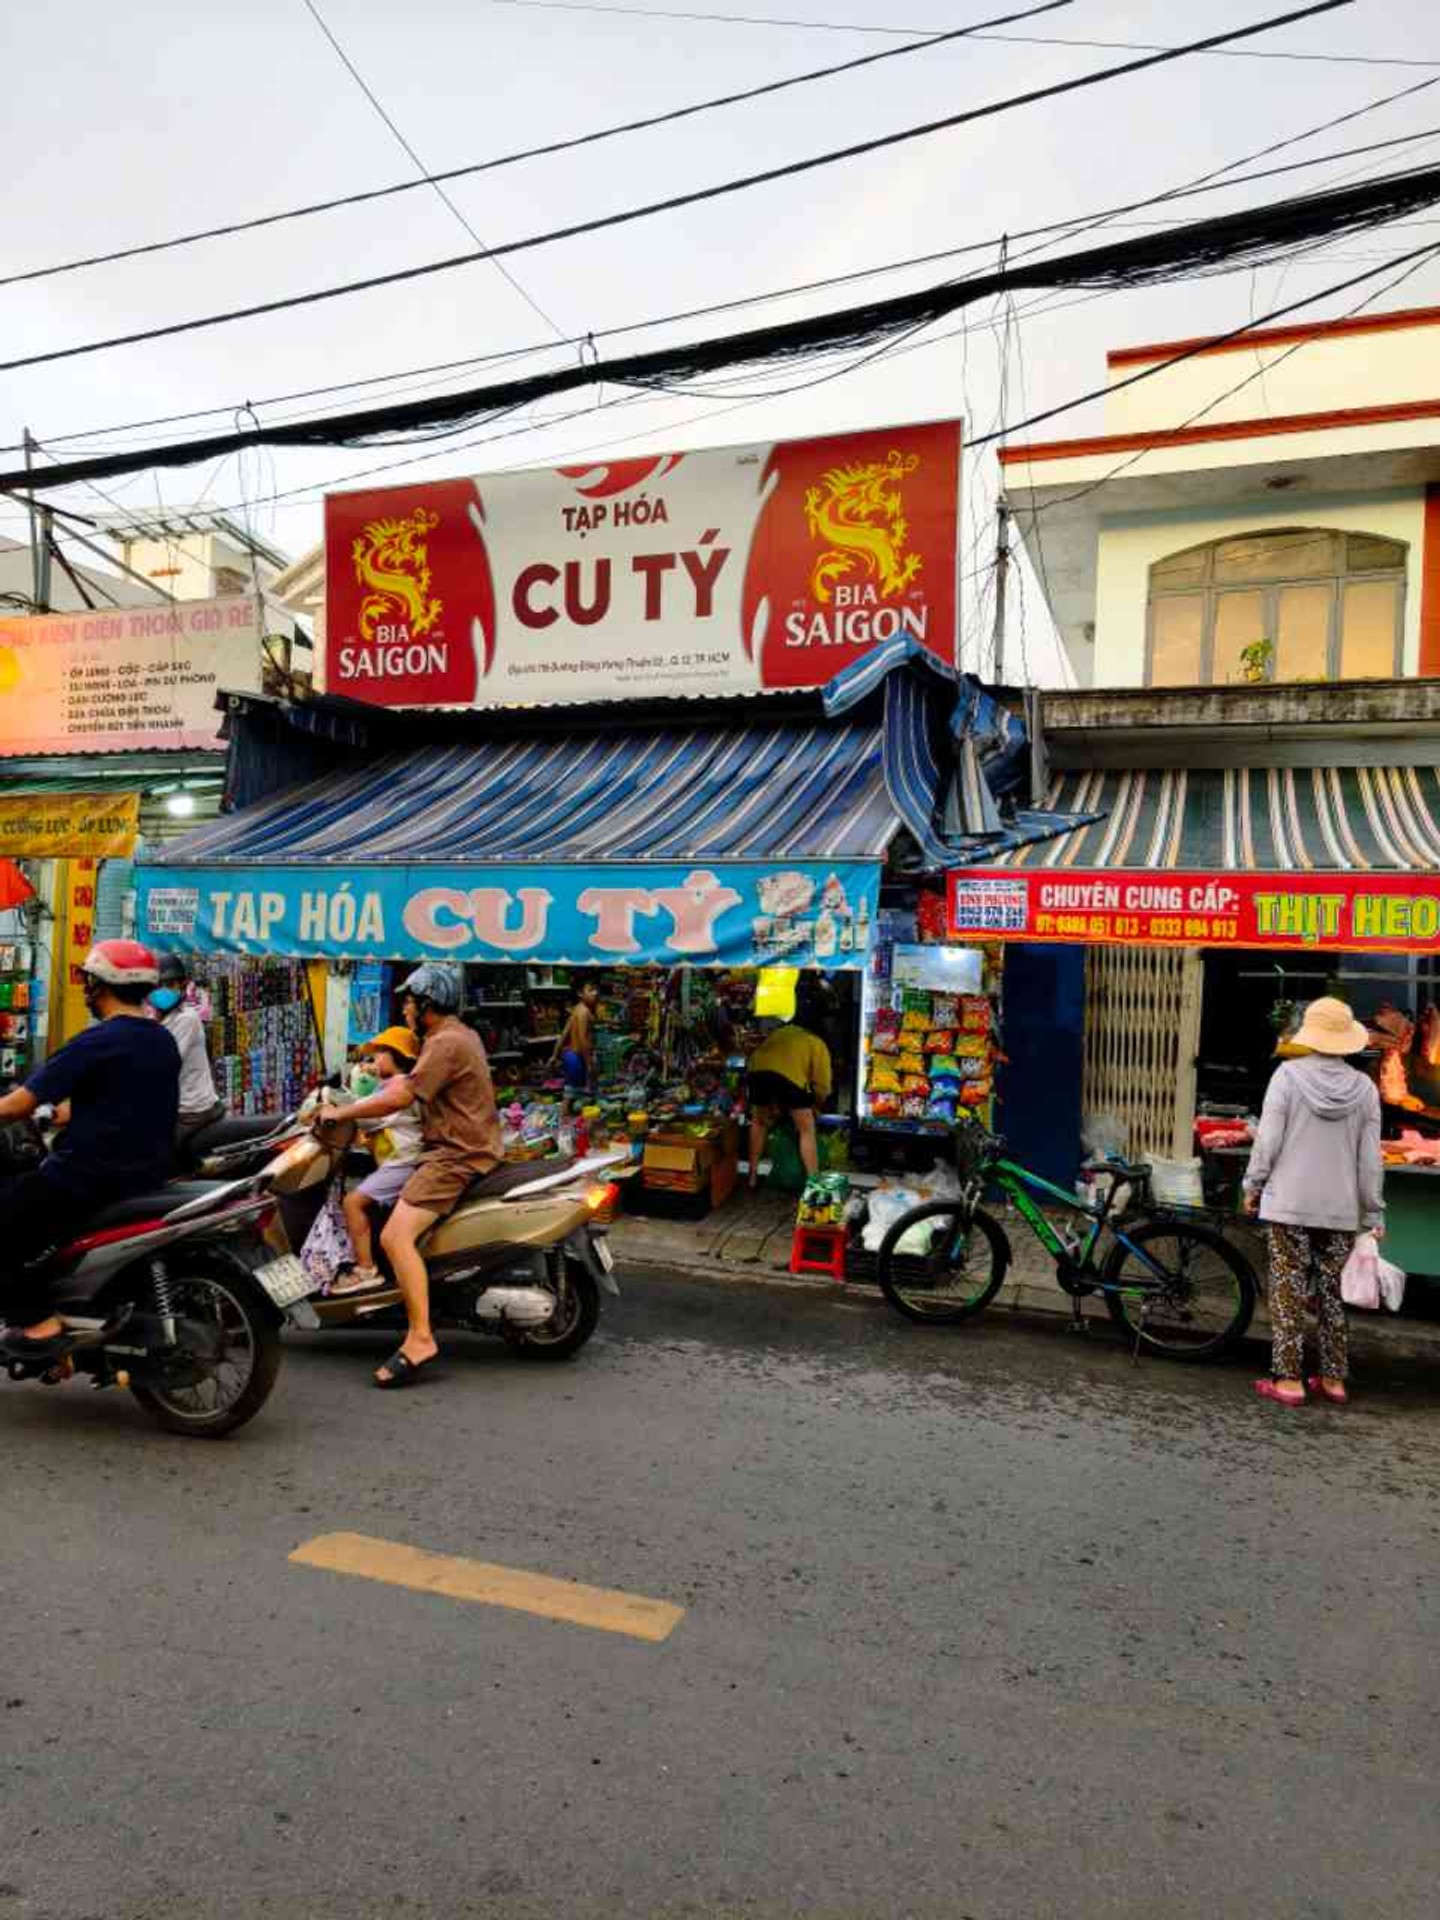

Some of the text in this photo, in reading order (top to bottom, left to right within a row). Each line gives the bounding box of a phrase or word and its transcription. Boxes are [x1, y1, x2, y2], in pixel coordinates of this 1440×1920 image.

[562, 493, 668, 538] TẠP HÓA
[512, 528, 731, 629] CU TÝ
[835, 583, 878, 607] BIA
[376, 624, 409, 644] BIA
[784, 604, 927, 646] SAIGON
[339, 643, 448, 678] SAIGON
[300, 882, 385, 942] HÓA
[402, 887, 552, 949] CU
[1041, 881, 1119, 908] CHUYÊN
[1126, 886, 1182, 909] CUNG
[1189, 878, 1240, 912] CẤP:
[1254, 892, 1438, 949] THỊT HEO
